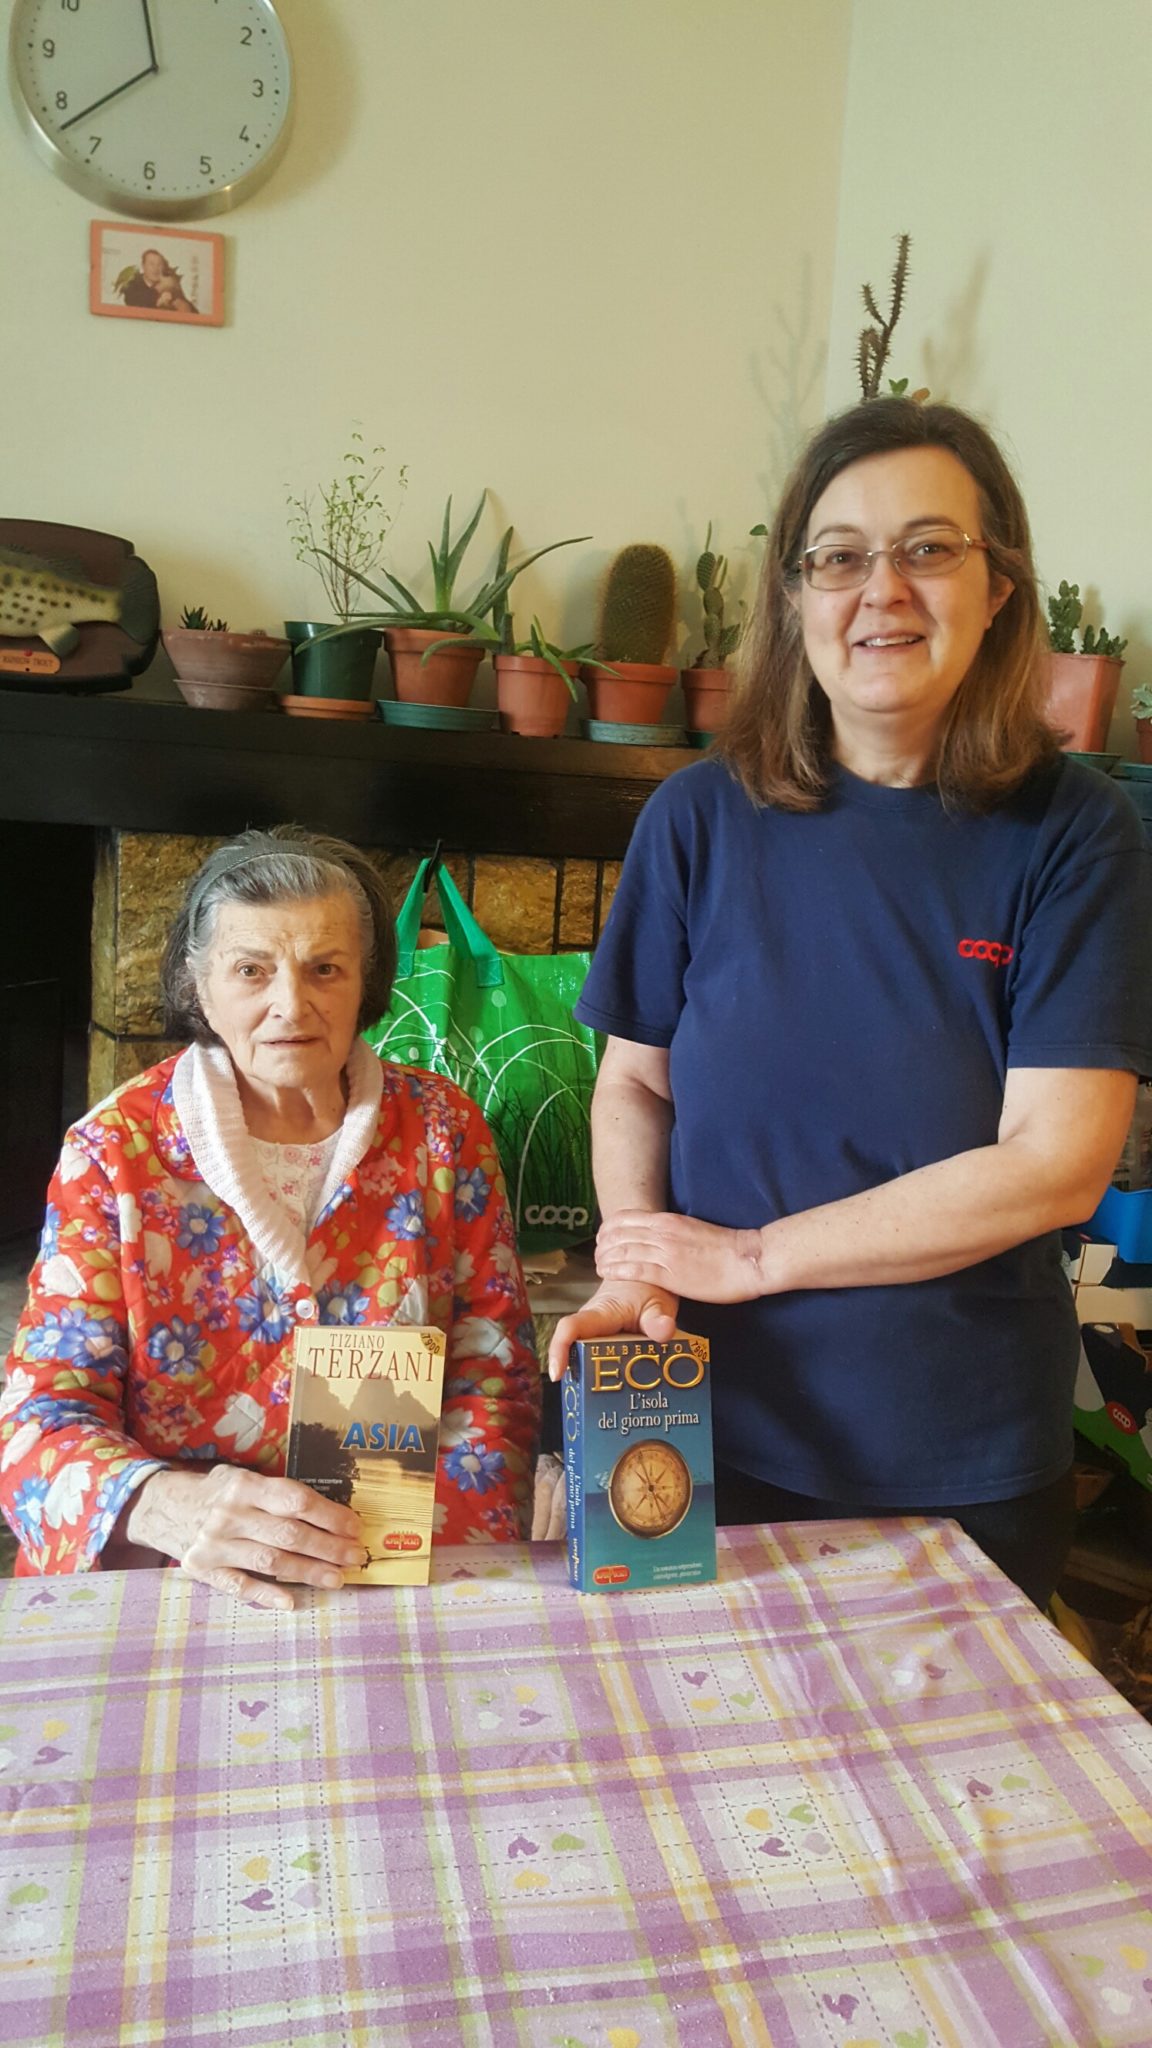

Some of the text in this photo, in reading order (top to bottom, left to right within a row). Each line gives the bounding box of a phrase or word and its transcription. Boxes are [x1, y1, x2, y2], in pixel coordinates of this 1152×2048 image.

[240, 26, 252, 45] 2
[42, 39, 55, 58] 9
[252, 79, 264, 97] 3
[55, 91, 68, 110] 8
[239, 125, 250, 142] 4
[89, 136, 102, 155] 7
[143, 162, 155, 181] 6
[200, 156, 212, 175] 5
[958, 938, 1014, 968] coop
[525, 1205, 589, 1230] coop
[330, 1333, 385, 1350] TIZIANO
[591, 1343, 683, 1356] UMBERTO
[308, 1347, 434, 1382] TERZANI
[591, 1352, 705, 1392] ECO
[630, 1391, 669, 1410] L'isola
[598, 1410, 700, 1435] del giorno prima
[340, 1421, 426, 1453] ASIA
